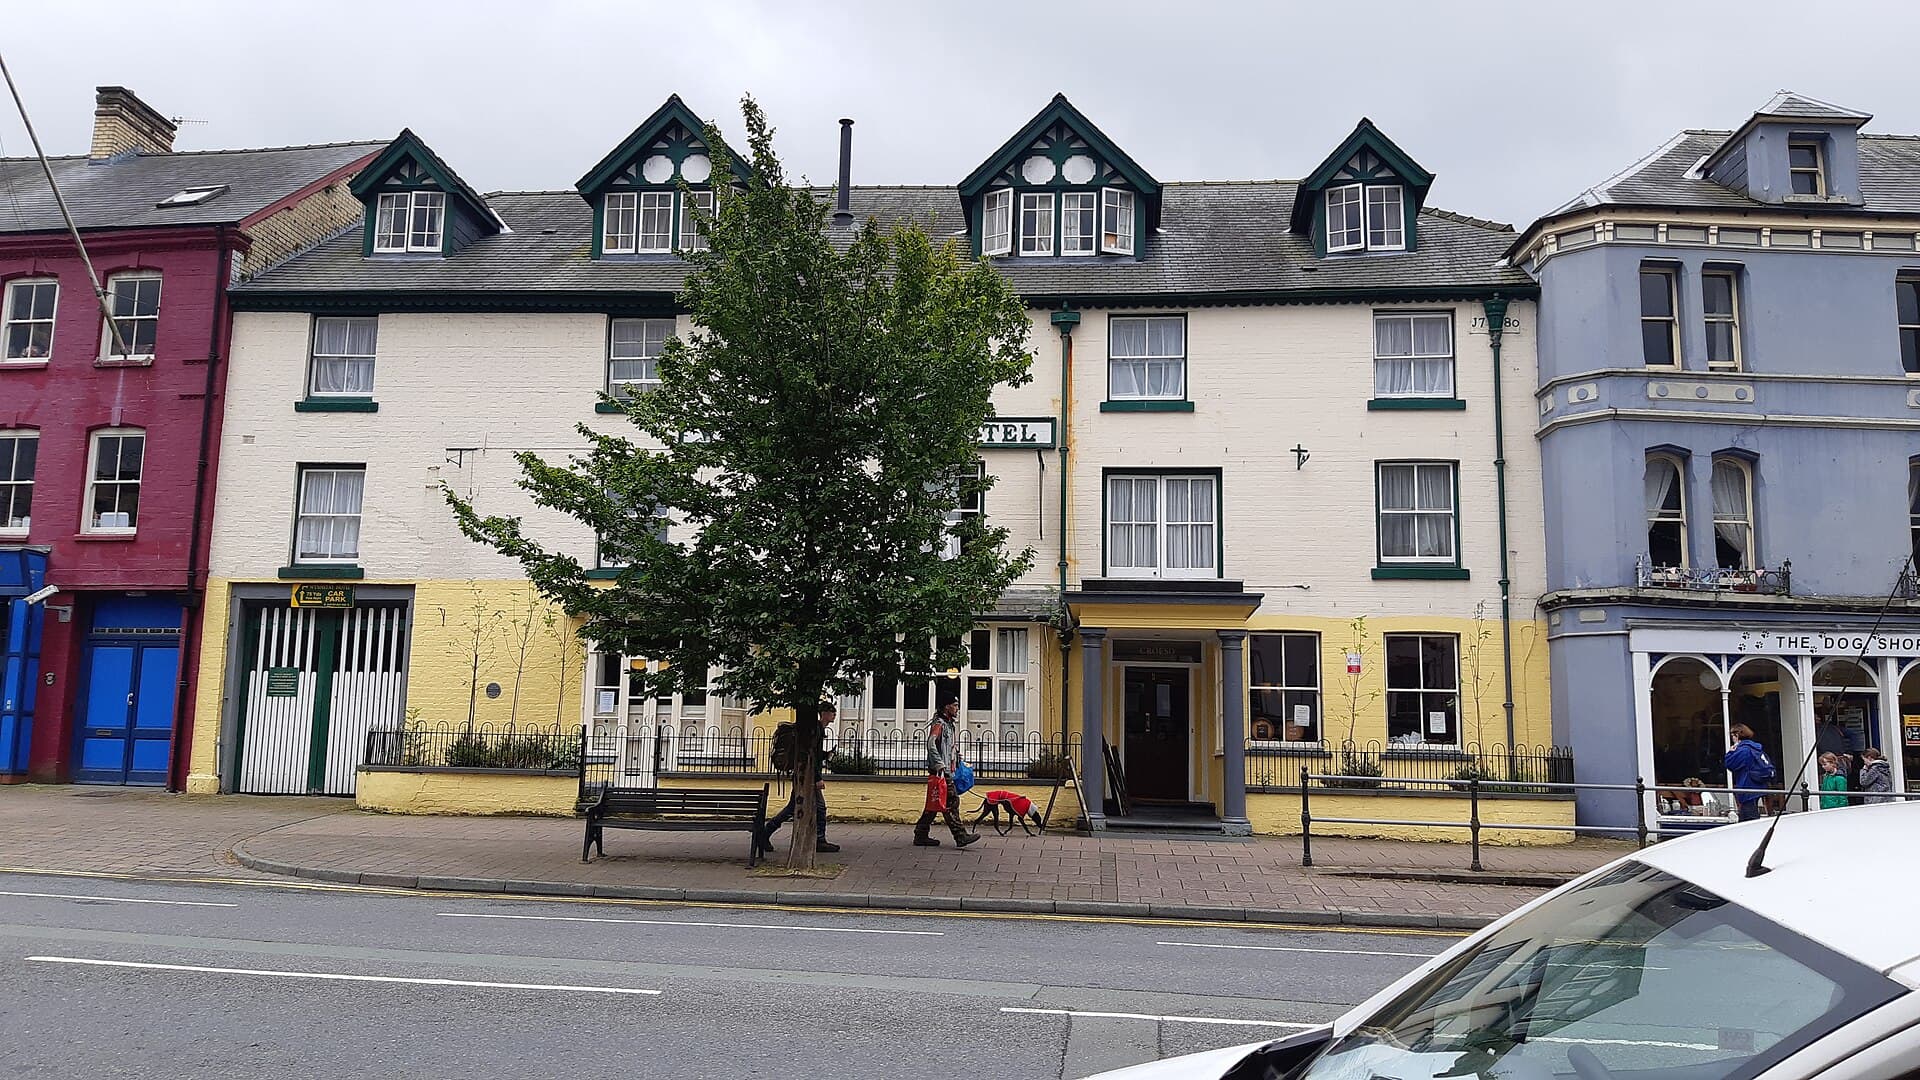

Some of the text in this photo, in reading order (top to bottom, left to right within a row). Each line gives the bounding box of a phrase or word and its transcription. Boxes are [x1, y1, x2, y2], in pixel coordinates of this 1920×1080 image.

[975, 424, 1037, 443] TEL
[1776, 636, 1811, 649] THE
[1824, 637, 1863, 650] DOG
